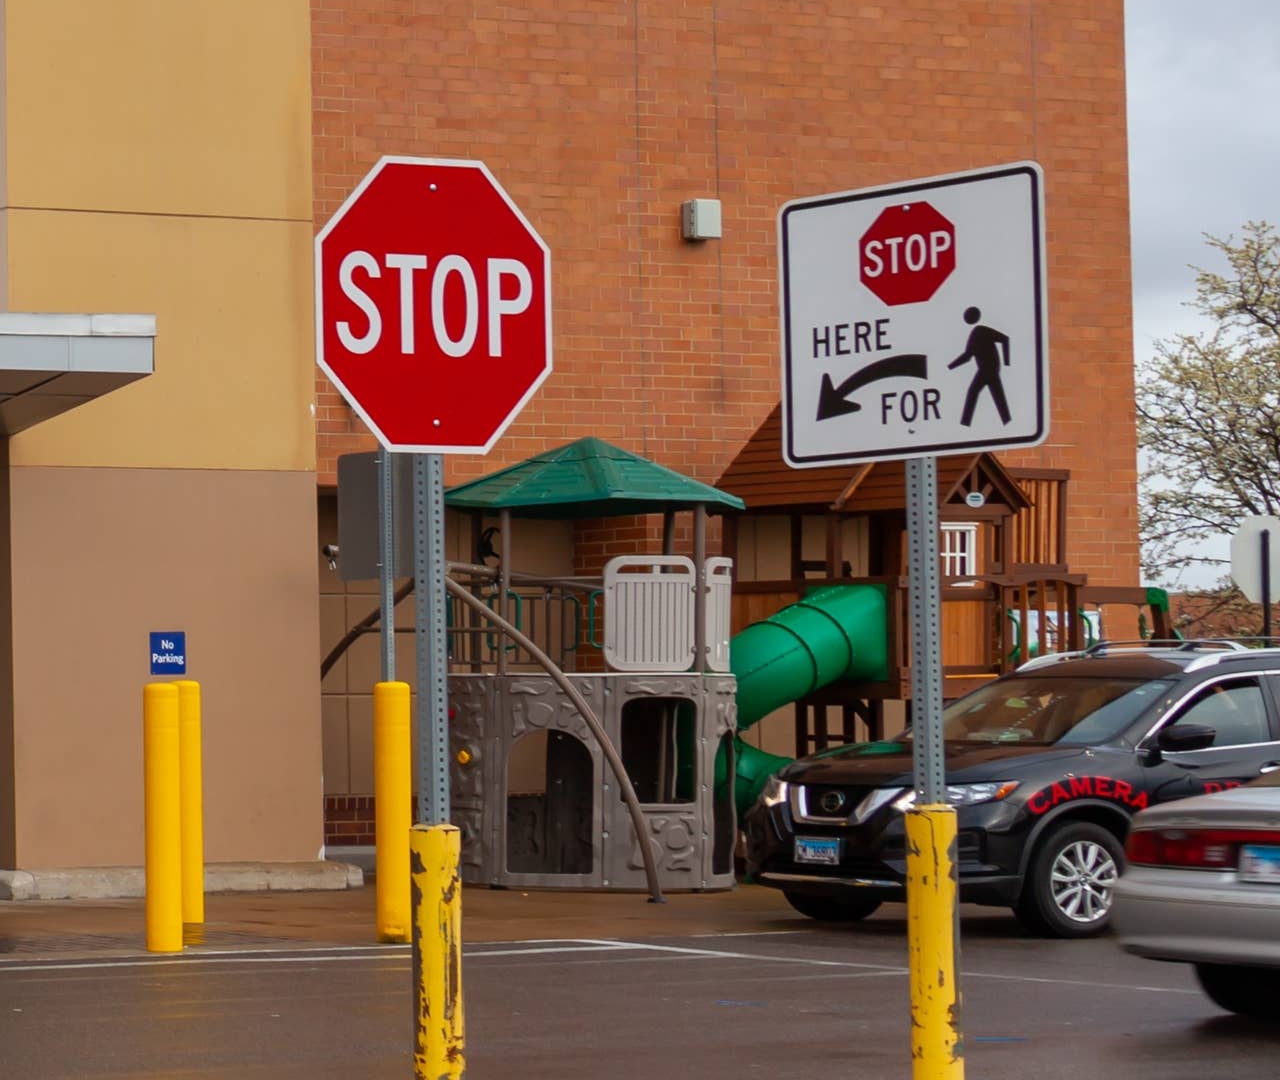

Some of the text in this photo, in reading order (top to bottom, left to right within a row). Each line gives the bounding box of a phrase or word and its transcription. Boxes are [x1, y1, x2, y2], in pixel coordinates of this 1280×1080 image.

[863, 230, 952, 279] STOP
[335, 249, 534, 359] STOP
[812, 318, 893, 360] HERE
[881, 387, 942, 426] FOR
[152, 652, 184, 666] Parking
[161, 639, 175, 650] No
[1026, 775, 1149, 815] CAMERA
